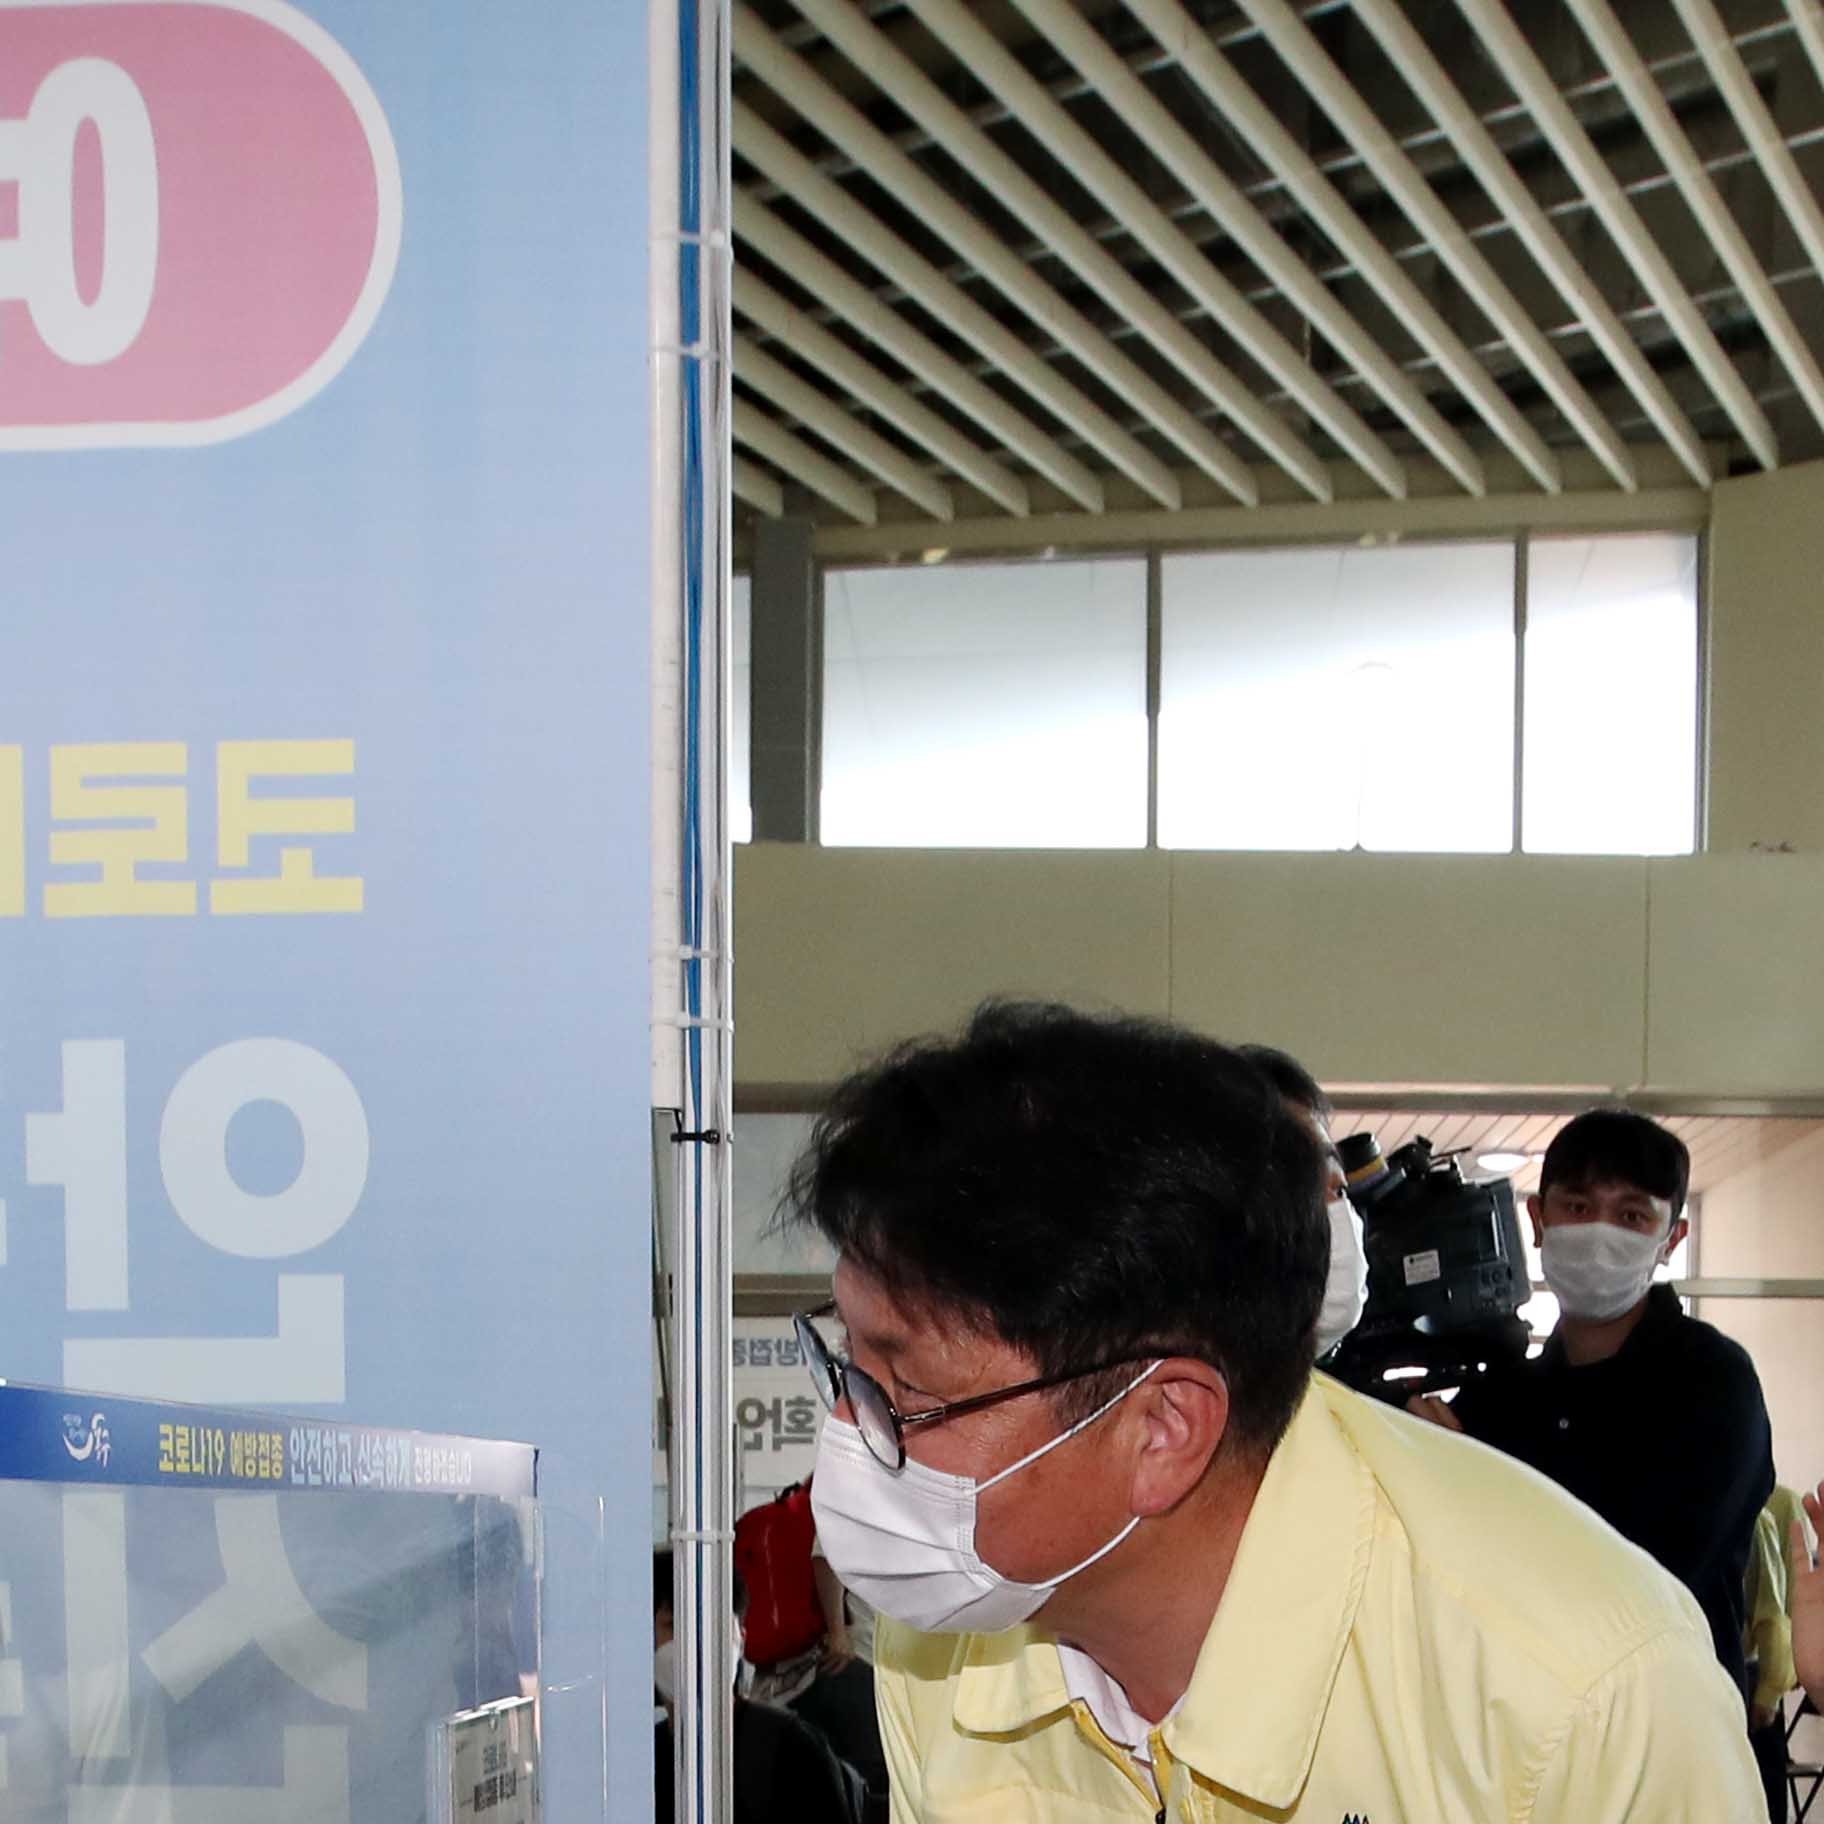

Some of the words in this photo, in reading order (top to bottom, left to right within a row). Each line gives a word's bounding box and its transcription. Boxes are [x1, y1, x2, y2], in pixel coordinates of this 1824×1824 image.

[159, 1423, 225, 1476] 코로나19
[230, 1431, 284, 1479] 예방접종
[289, 1427, 352, 1485] 안전하고
